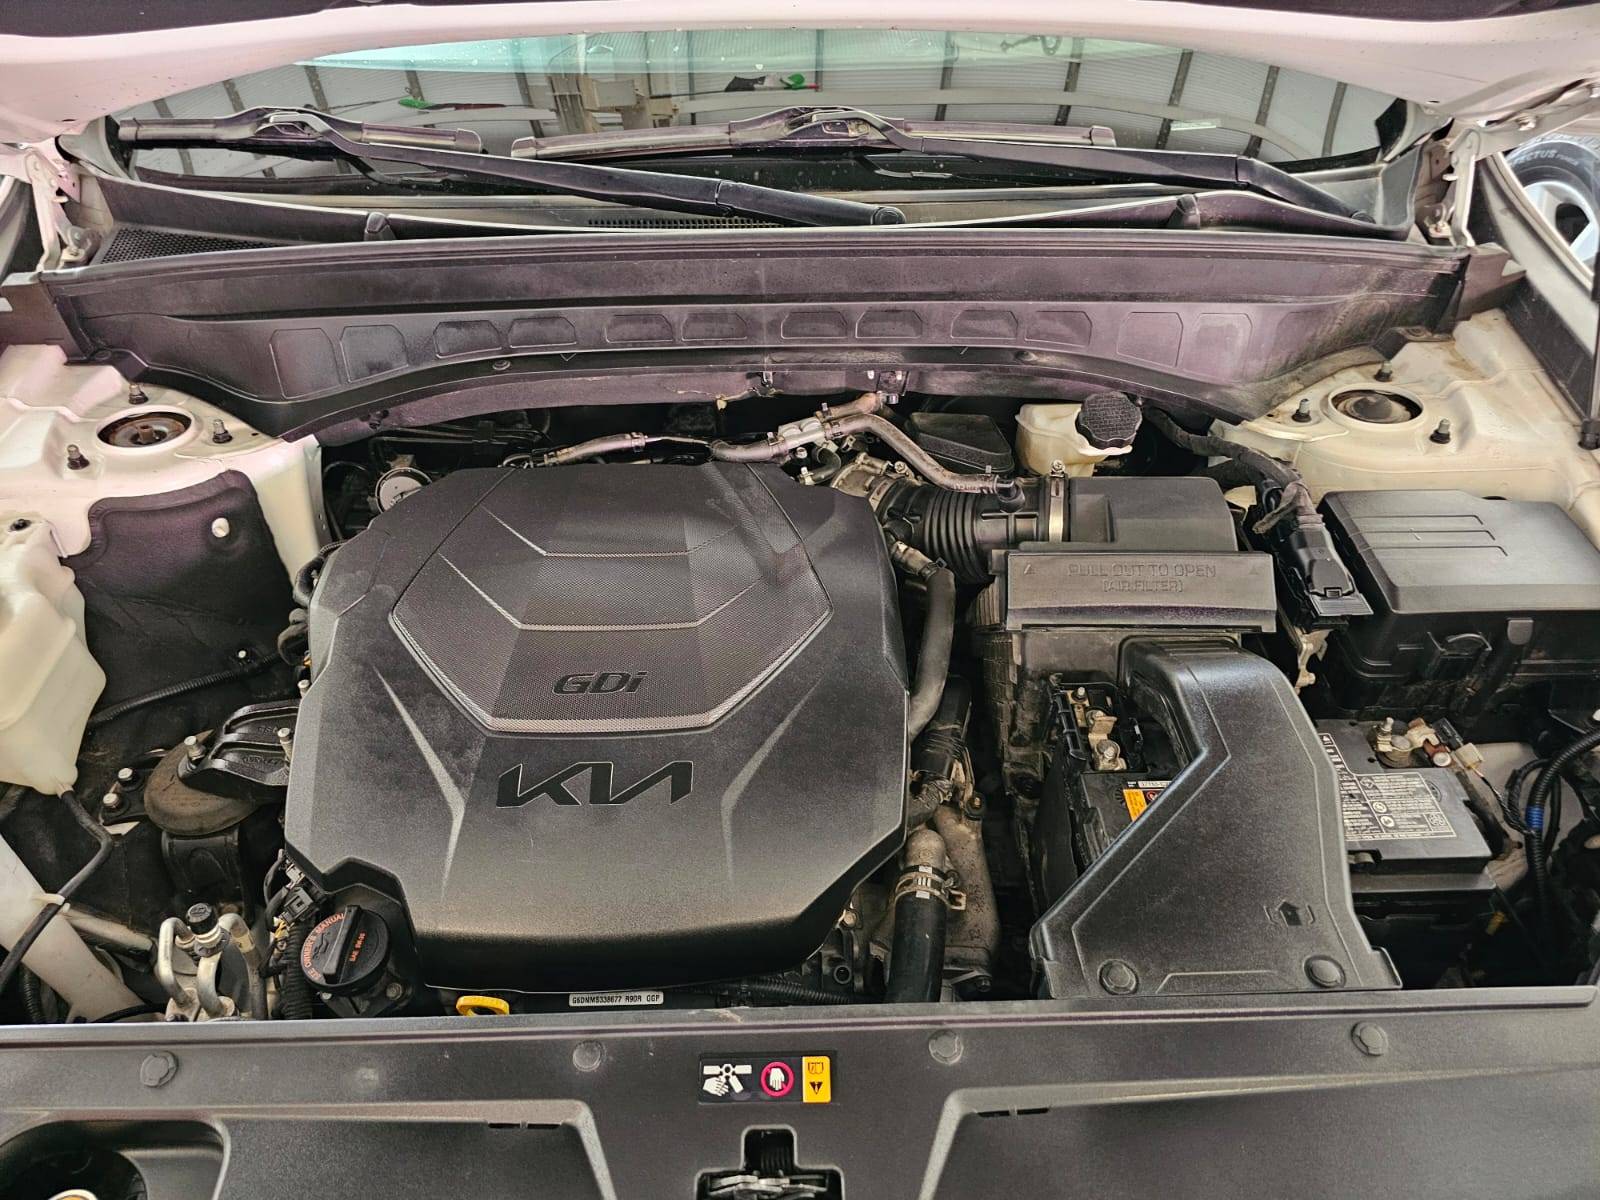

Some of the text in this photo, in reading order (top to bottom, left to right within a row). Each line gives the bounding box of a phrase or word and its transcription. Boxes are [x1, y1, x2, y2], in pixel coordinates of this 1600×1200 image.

[1068, 564, 1217, 578] PULL OUT TO OPEN
[553, 672, 648, 695] GDi
[496, 760, 694, 808] KIA
[315, 913, 344, 934] MANUAL
